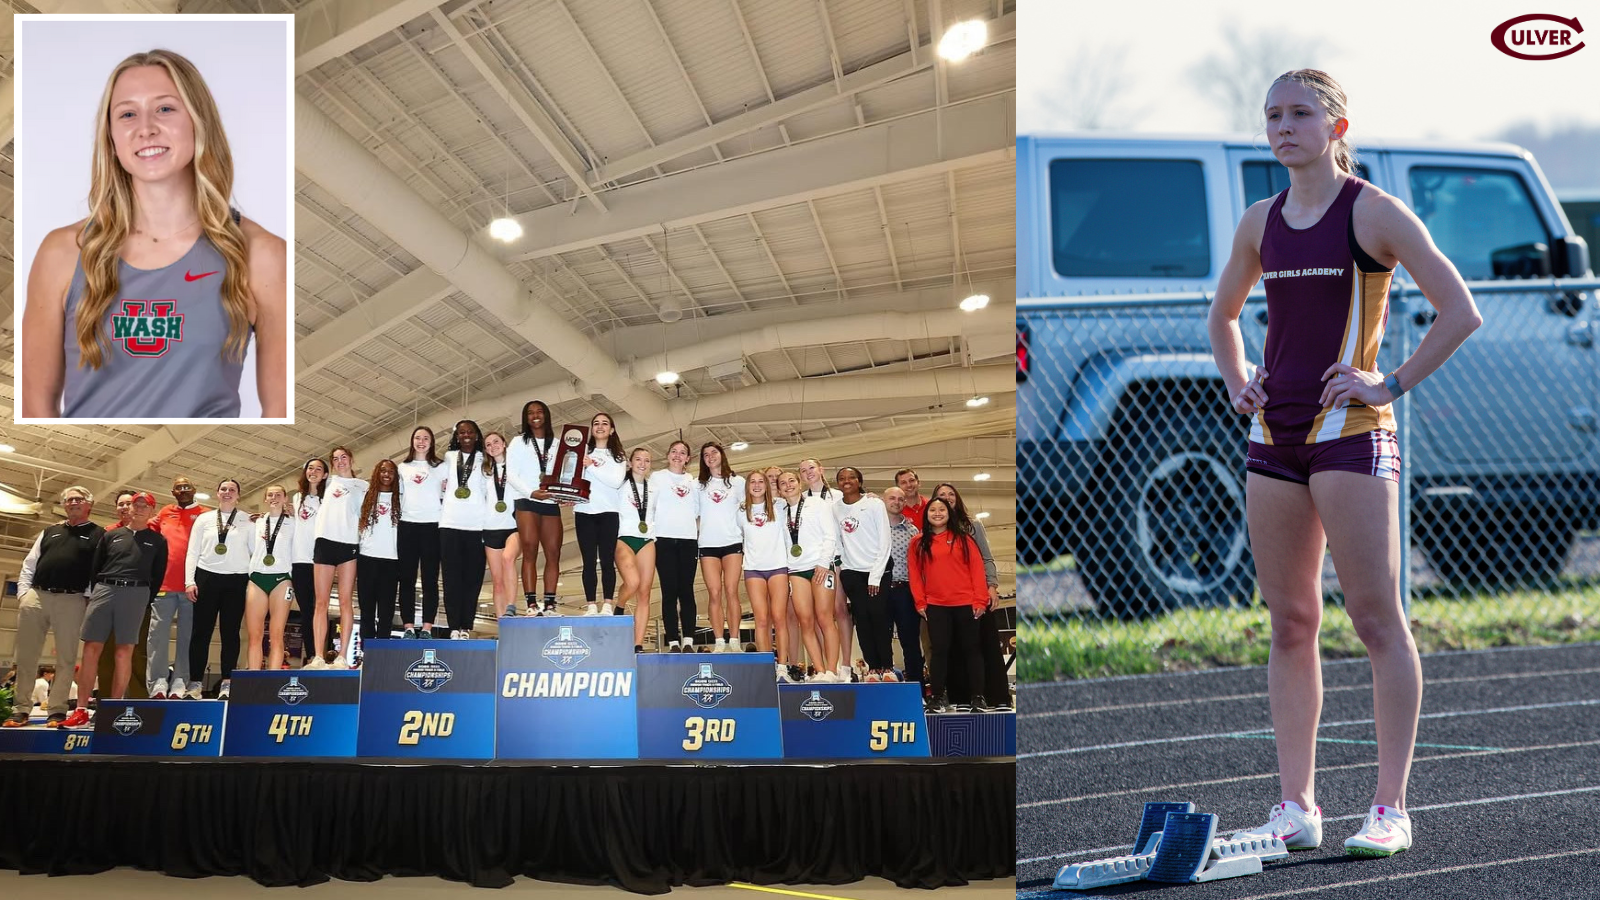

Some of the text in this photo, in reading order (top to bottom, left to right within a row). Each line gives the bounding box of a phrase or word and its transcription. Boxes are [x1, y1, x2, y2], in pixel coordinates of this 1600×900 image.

[1279, 269, 1300, 278] GIRLS
[1302, 268, 1344, 276] ACADEMY
[112, 315, 184, 341] WASH
[822, 574, 834, 589] 5
[406, 671, 451, 679] CHAMPIONSHIPS
[501, 671, 633, 698] CHAMPION
[683, 686, 730, 694] CHAMPIONSHIPS
[171, 723, 213, 750] 6TH
[268, 714, 313, 743] 4TH
[398, 710, 455, 745] 2ND
[682, 716, 736, 751] 3RD
[870, 720, 915, 751] 5TH
[64, 734, 90, 750] 8TH
